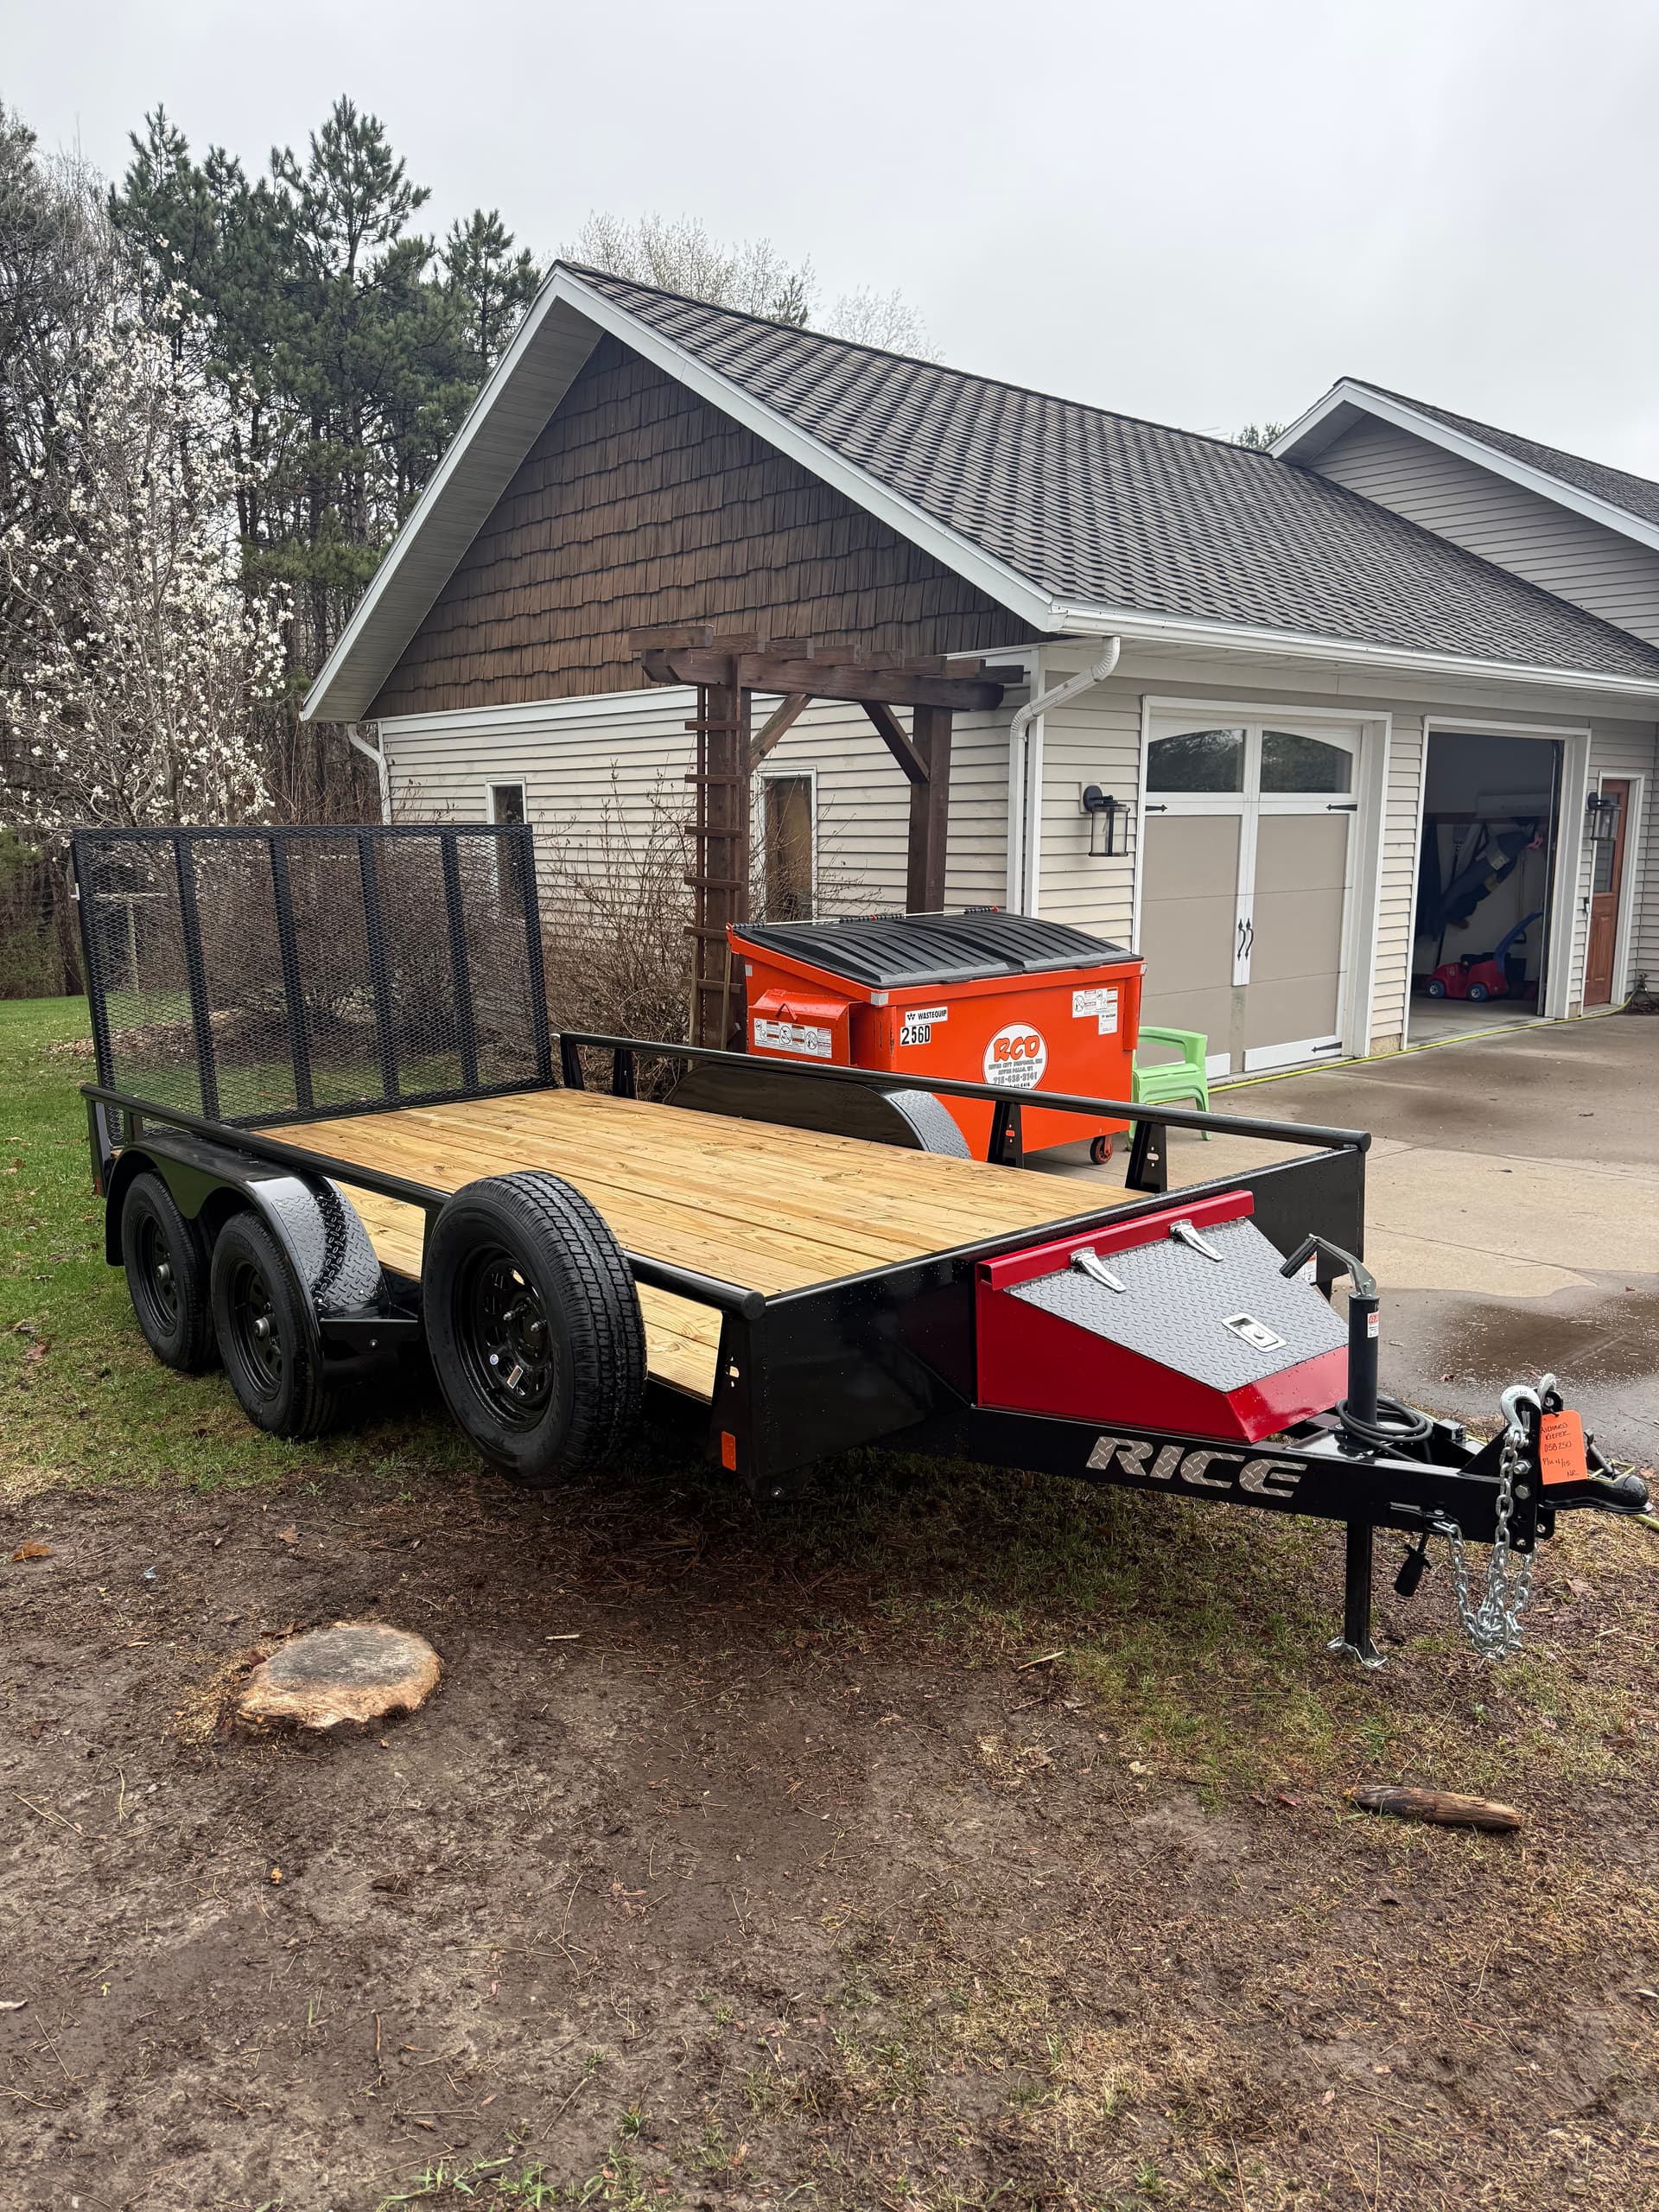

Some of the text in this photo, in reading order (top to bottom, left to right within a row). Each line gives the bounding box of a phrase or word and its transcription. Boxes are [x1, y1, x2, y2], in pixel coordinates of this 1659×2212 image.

[918, 1009, 947, 1020] WASTEQUIP
[994, 1035, 1040, 1062] RCD
[1085, 1435, 1308, 1498] RICE
